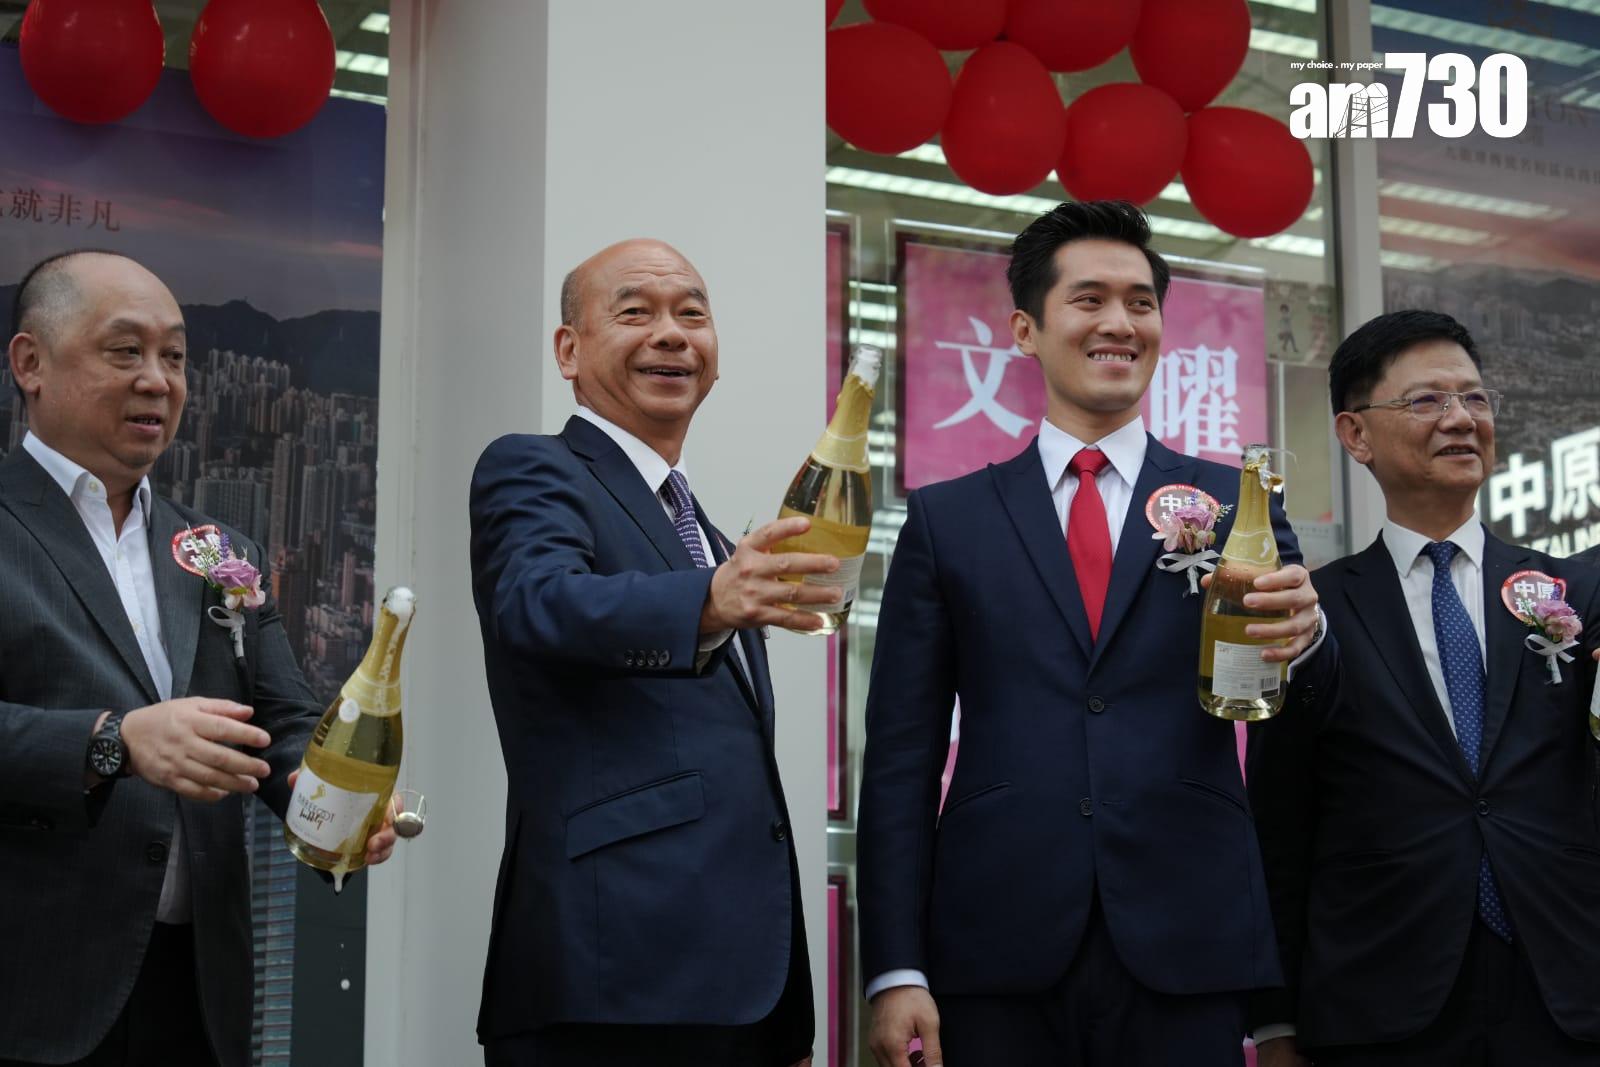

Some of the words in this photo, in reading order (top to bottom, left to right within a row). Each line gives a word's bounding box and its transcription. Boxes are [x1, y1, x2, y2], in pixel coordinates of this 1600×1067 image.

[0, 187, 121, 233] 就非凡
[1489, 426, 1600, 538] 中原
[1513, 580, 1556, 600] 中原
